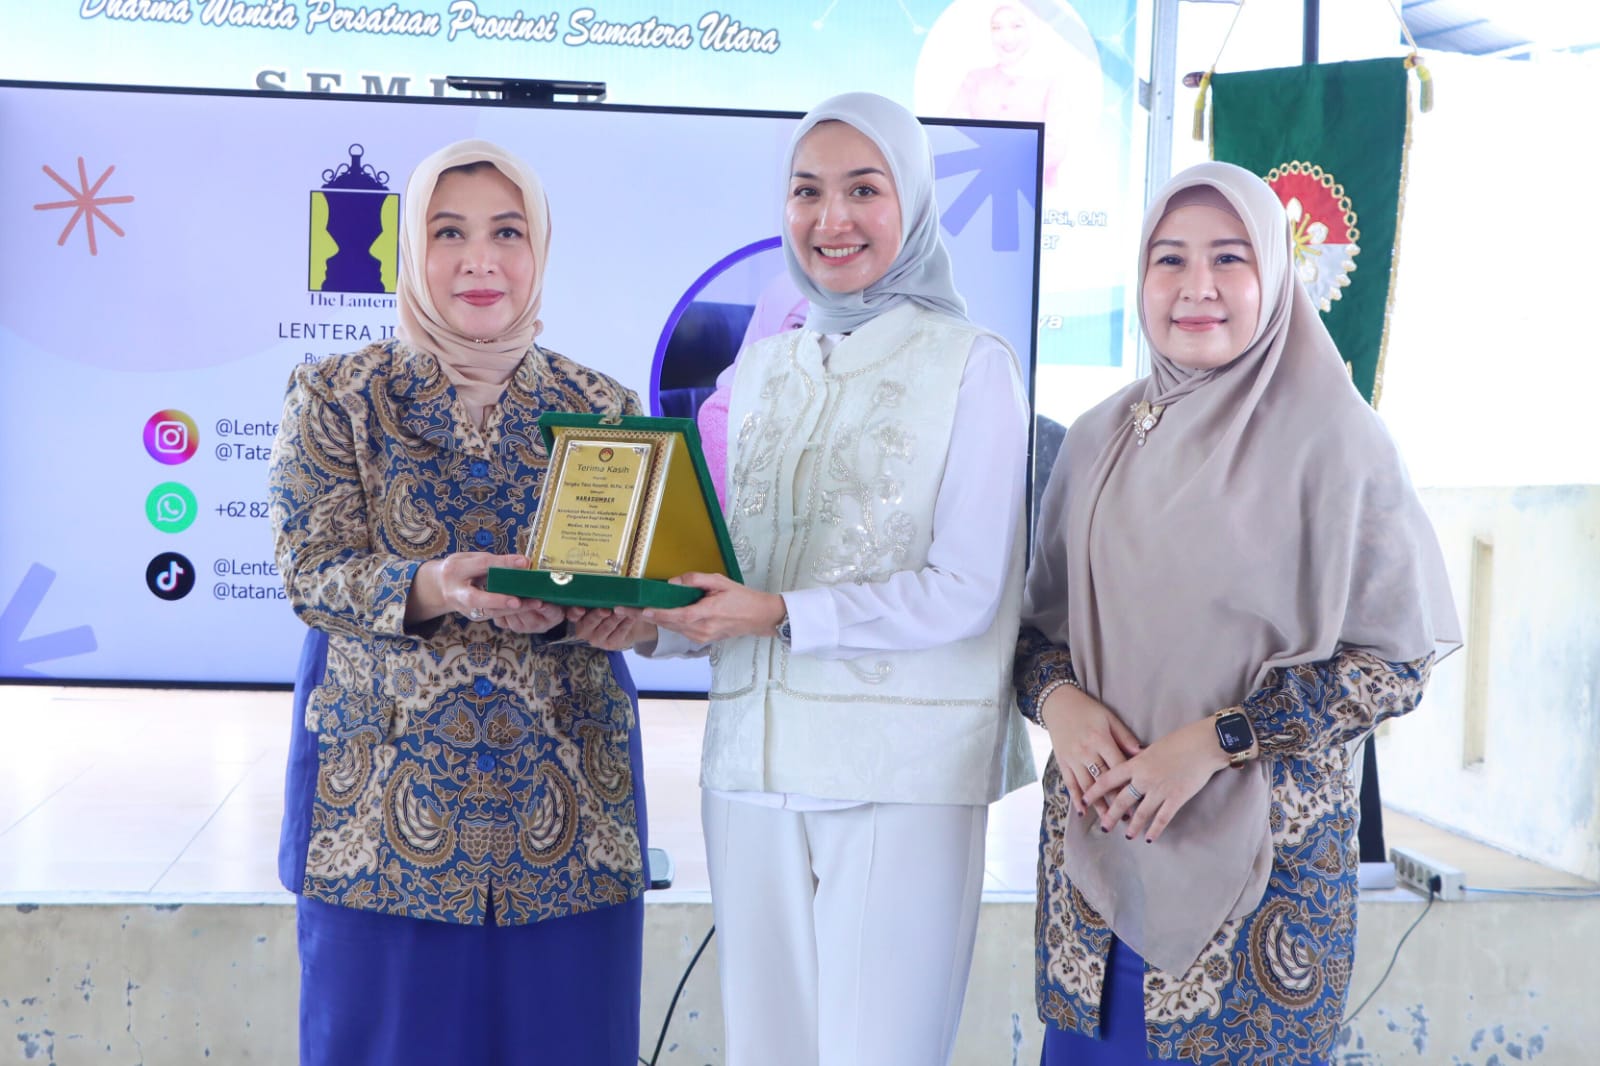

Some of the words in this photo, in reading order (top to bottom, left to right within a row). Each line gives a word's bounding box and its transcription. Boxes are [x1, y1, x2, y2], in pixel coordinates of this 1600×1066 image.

[80, 0, 192, 24] Dharma
[199, 0, 298, 30] Wanita
[305, 0, 440, 36] Persatuan
[447, 1, 560, 42] Provinsi
[563, 8, 694, 50] Sumatera
[699, 11, 781, 54] Utara
[309, 293, 336, 307] The
[278, 322, 371, 341] LENTERA
[577, 463, 605, 472] Terima
[606, 464, 630, 473] Kasih
[215, 501, 245, 518] +62
[249, 501, 270, 518] 82
